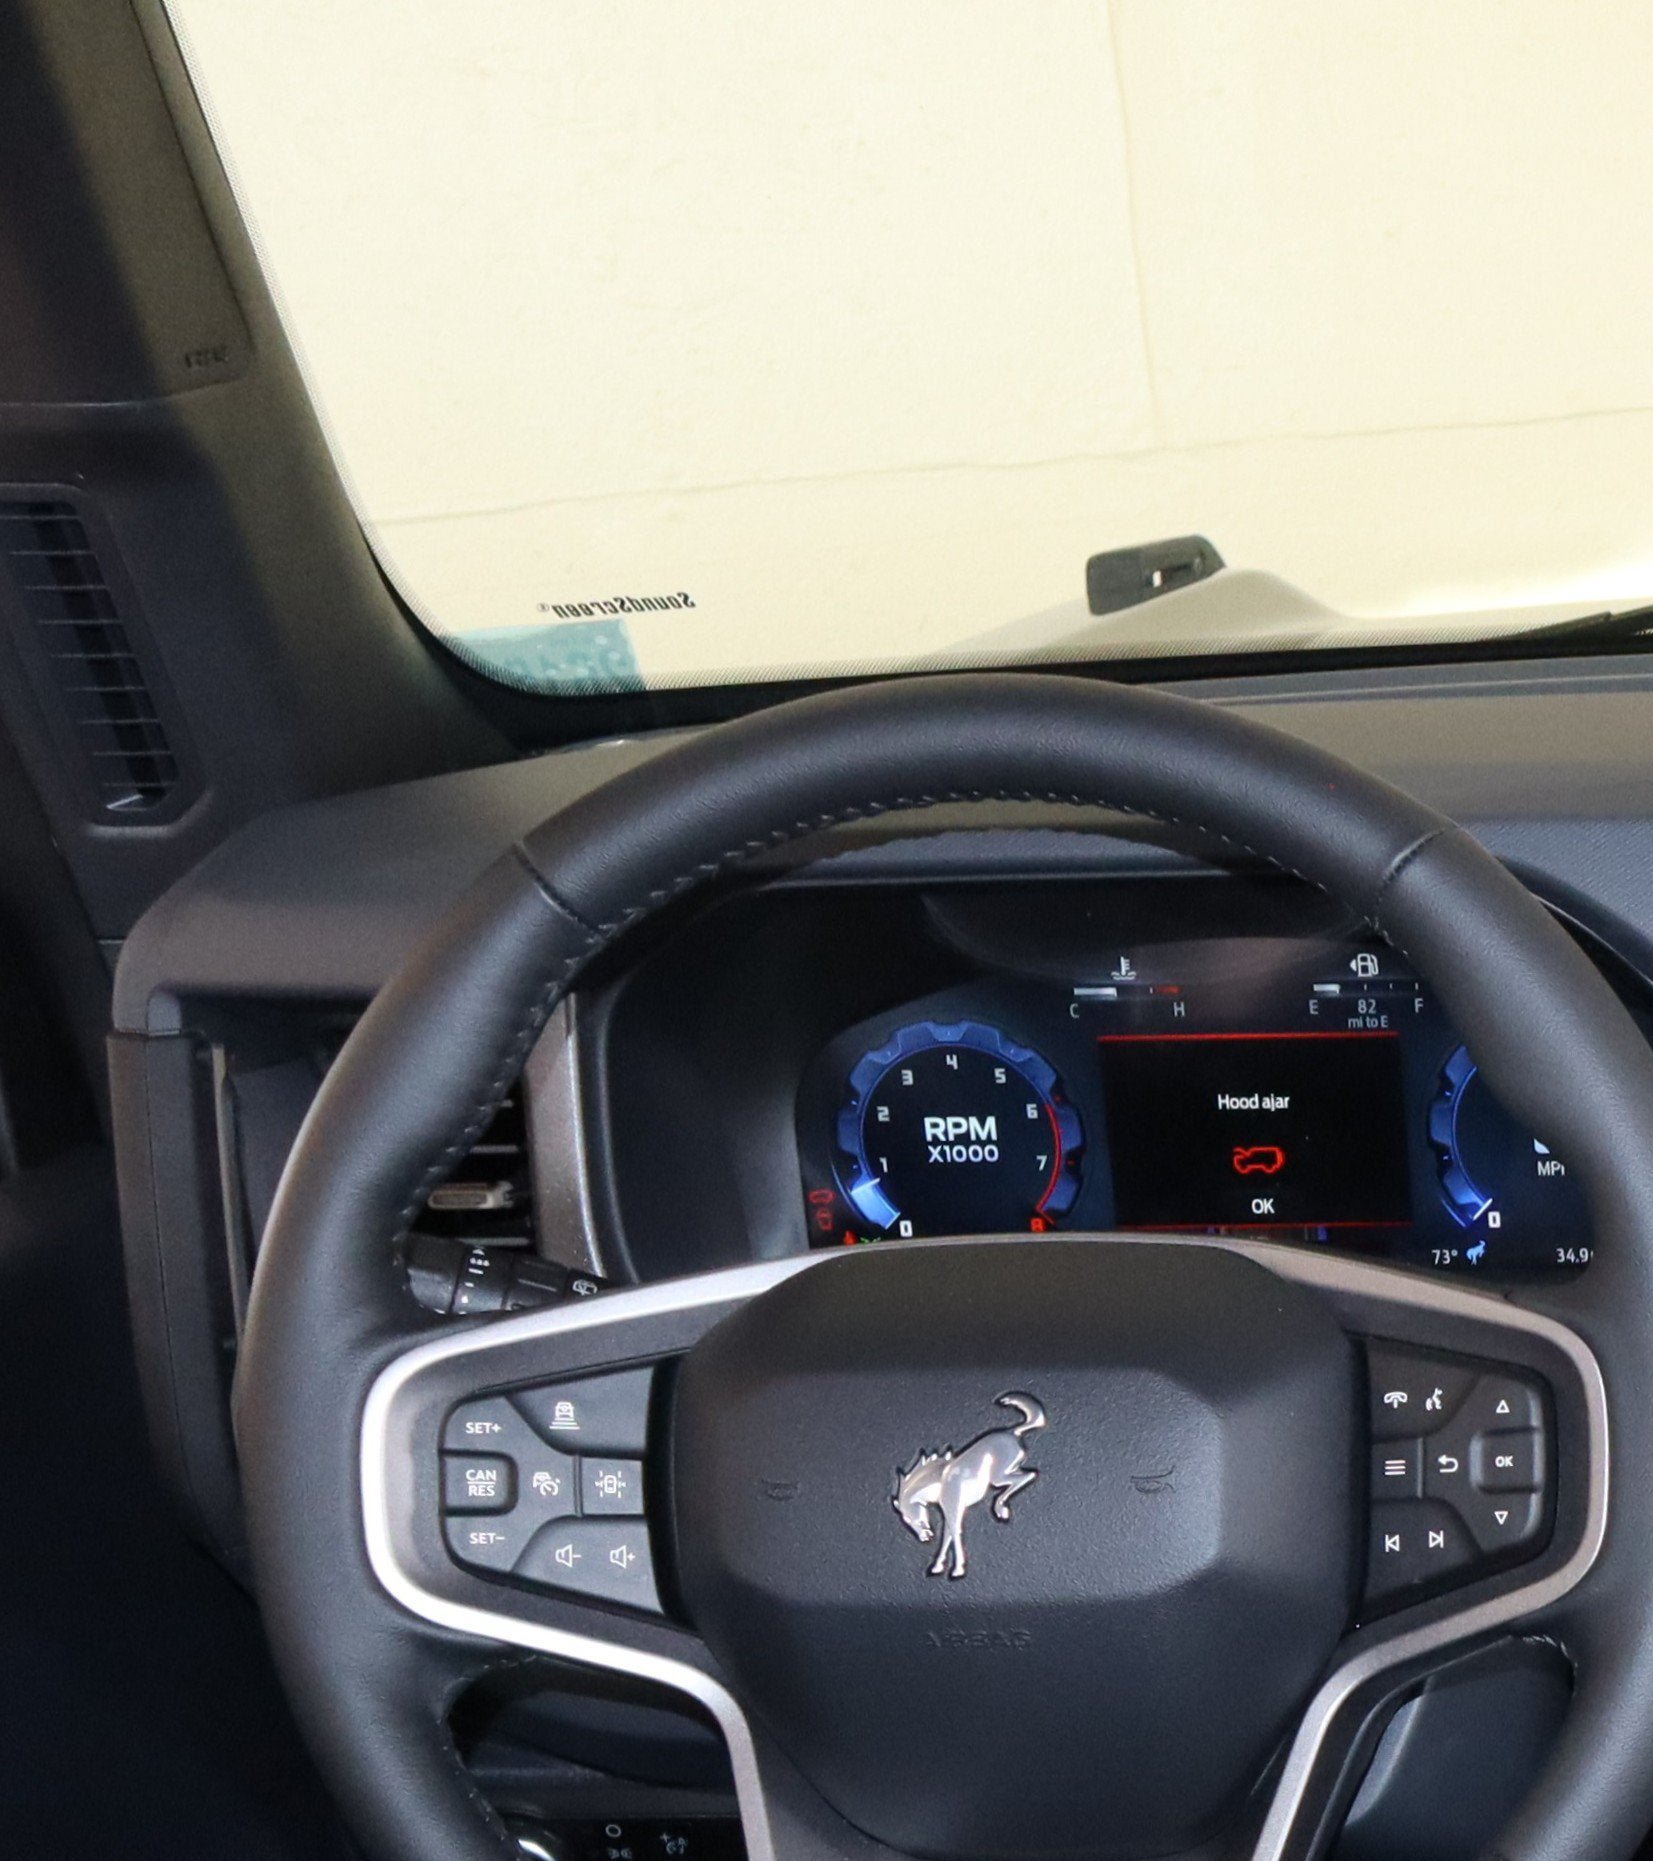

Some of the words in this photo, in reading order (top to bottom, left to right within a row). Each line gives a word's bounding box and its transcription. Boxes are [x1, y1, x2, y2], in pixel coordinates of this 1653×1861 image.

[1070, 1003, 1080, 1018] C
[1174, 1002, 1185, 1017] H
[1309, 1000, 1319, 1015] E
[1357, 1000, 1377, 1014] 82
[1415, 999, 1424, 1013] F
[1348, 1016, 1364, 1028] mi
[1366, 1016, 1379, 1028] to
[1381, 1016, 1389, 1028] E
[946, 1054, 959, 1070] 4
[901, 1070, 914, 1085] 3
[994, 1068, 1006, 1084] 5
[1218, 1094, 1259, 1110] Hood
[1262, 1095, 1290, 1112] ajar
[877, 1106, 891, 1122] 2
[1026, 1103, 1038, 1119] 6
[924, 1116, 998, 1142] RPM
[880, 1157, 888, 1173] 1
[1036, 1155, 1047, 1171] 7
[1252, 1199, 1275, 1214] OK
[1488, 1211, 1501, 1228] 0
[900, 1220, 913, 1237] 0
[1432, 1249, 1457, 1265] 73°
[465, 1421, 502, 1434] SET+
[1495, 1455, 1513, 1467] OK
[466, 1469, 496, 1481] CAN
[468, 1485, 495, 1497] RES
